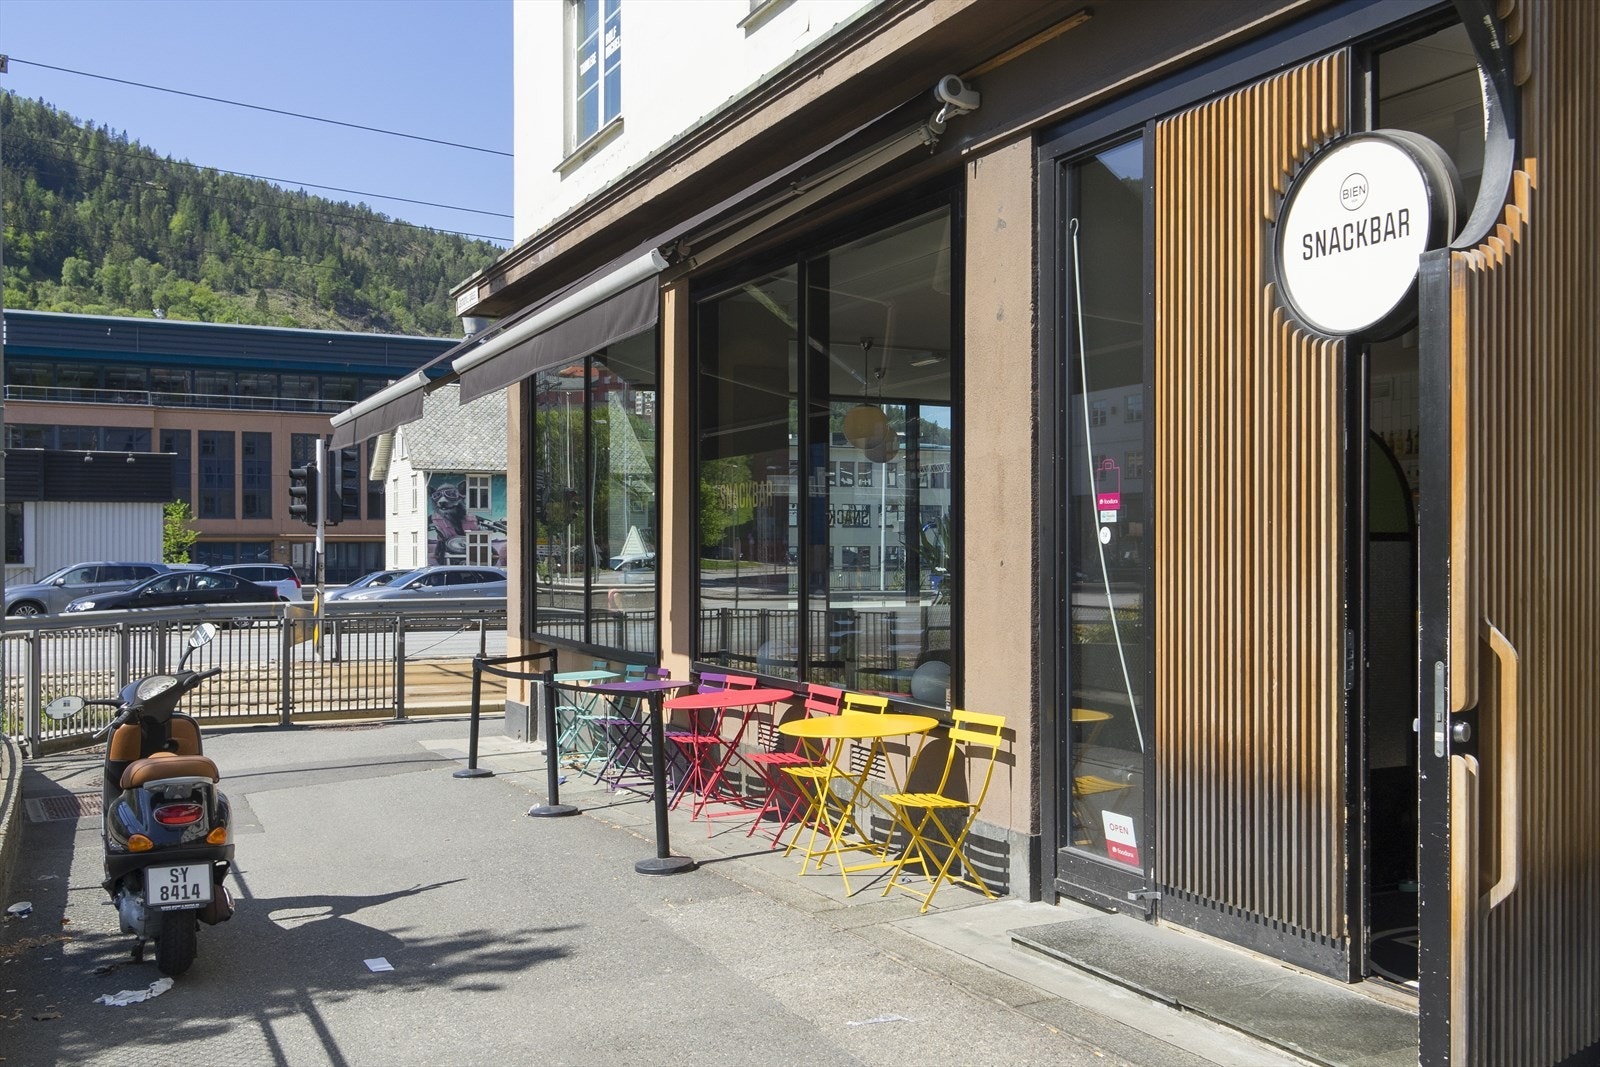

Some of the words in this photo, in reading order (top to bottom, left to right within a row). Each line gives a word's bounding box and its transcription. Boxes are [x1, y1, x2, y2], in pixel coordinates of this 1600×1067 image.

[1342, 184, 1367, 200] BIEN
[1302, 208, 1410, 261] SNACKBAR
[720, 480, 773, 510] SNACKBAR
[1109, 822, 1129, 835] OPEN
[170, 866, 189, 883] SY
[160, 883, 201, 901] 8414
